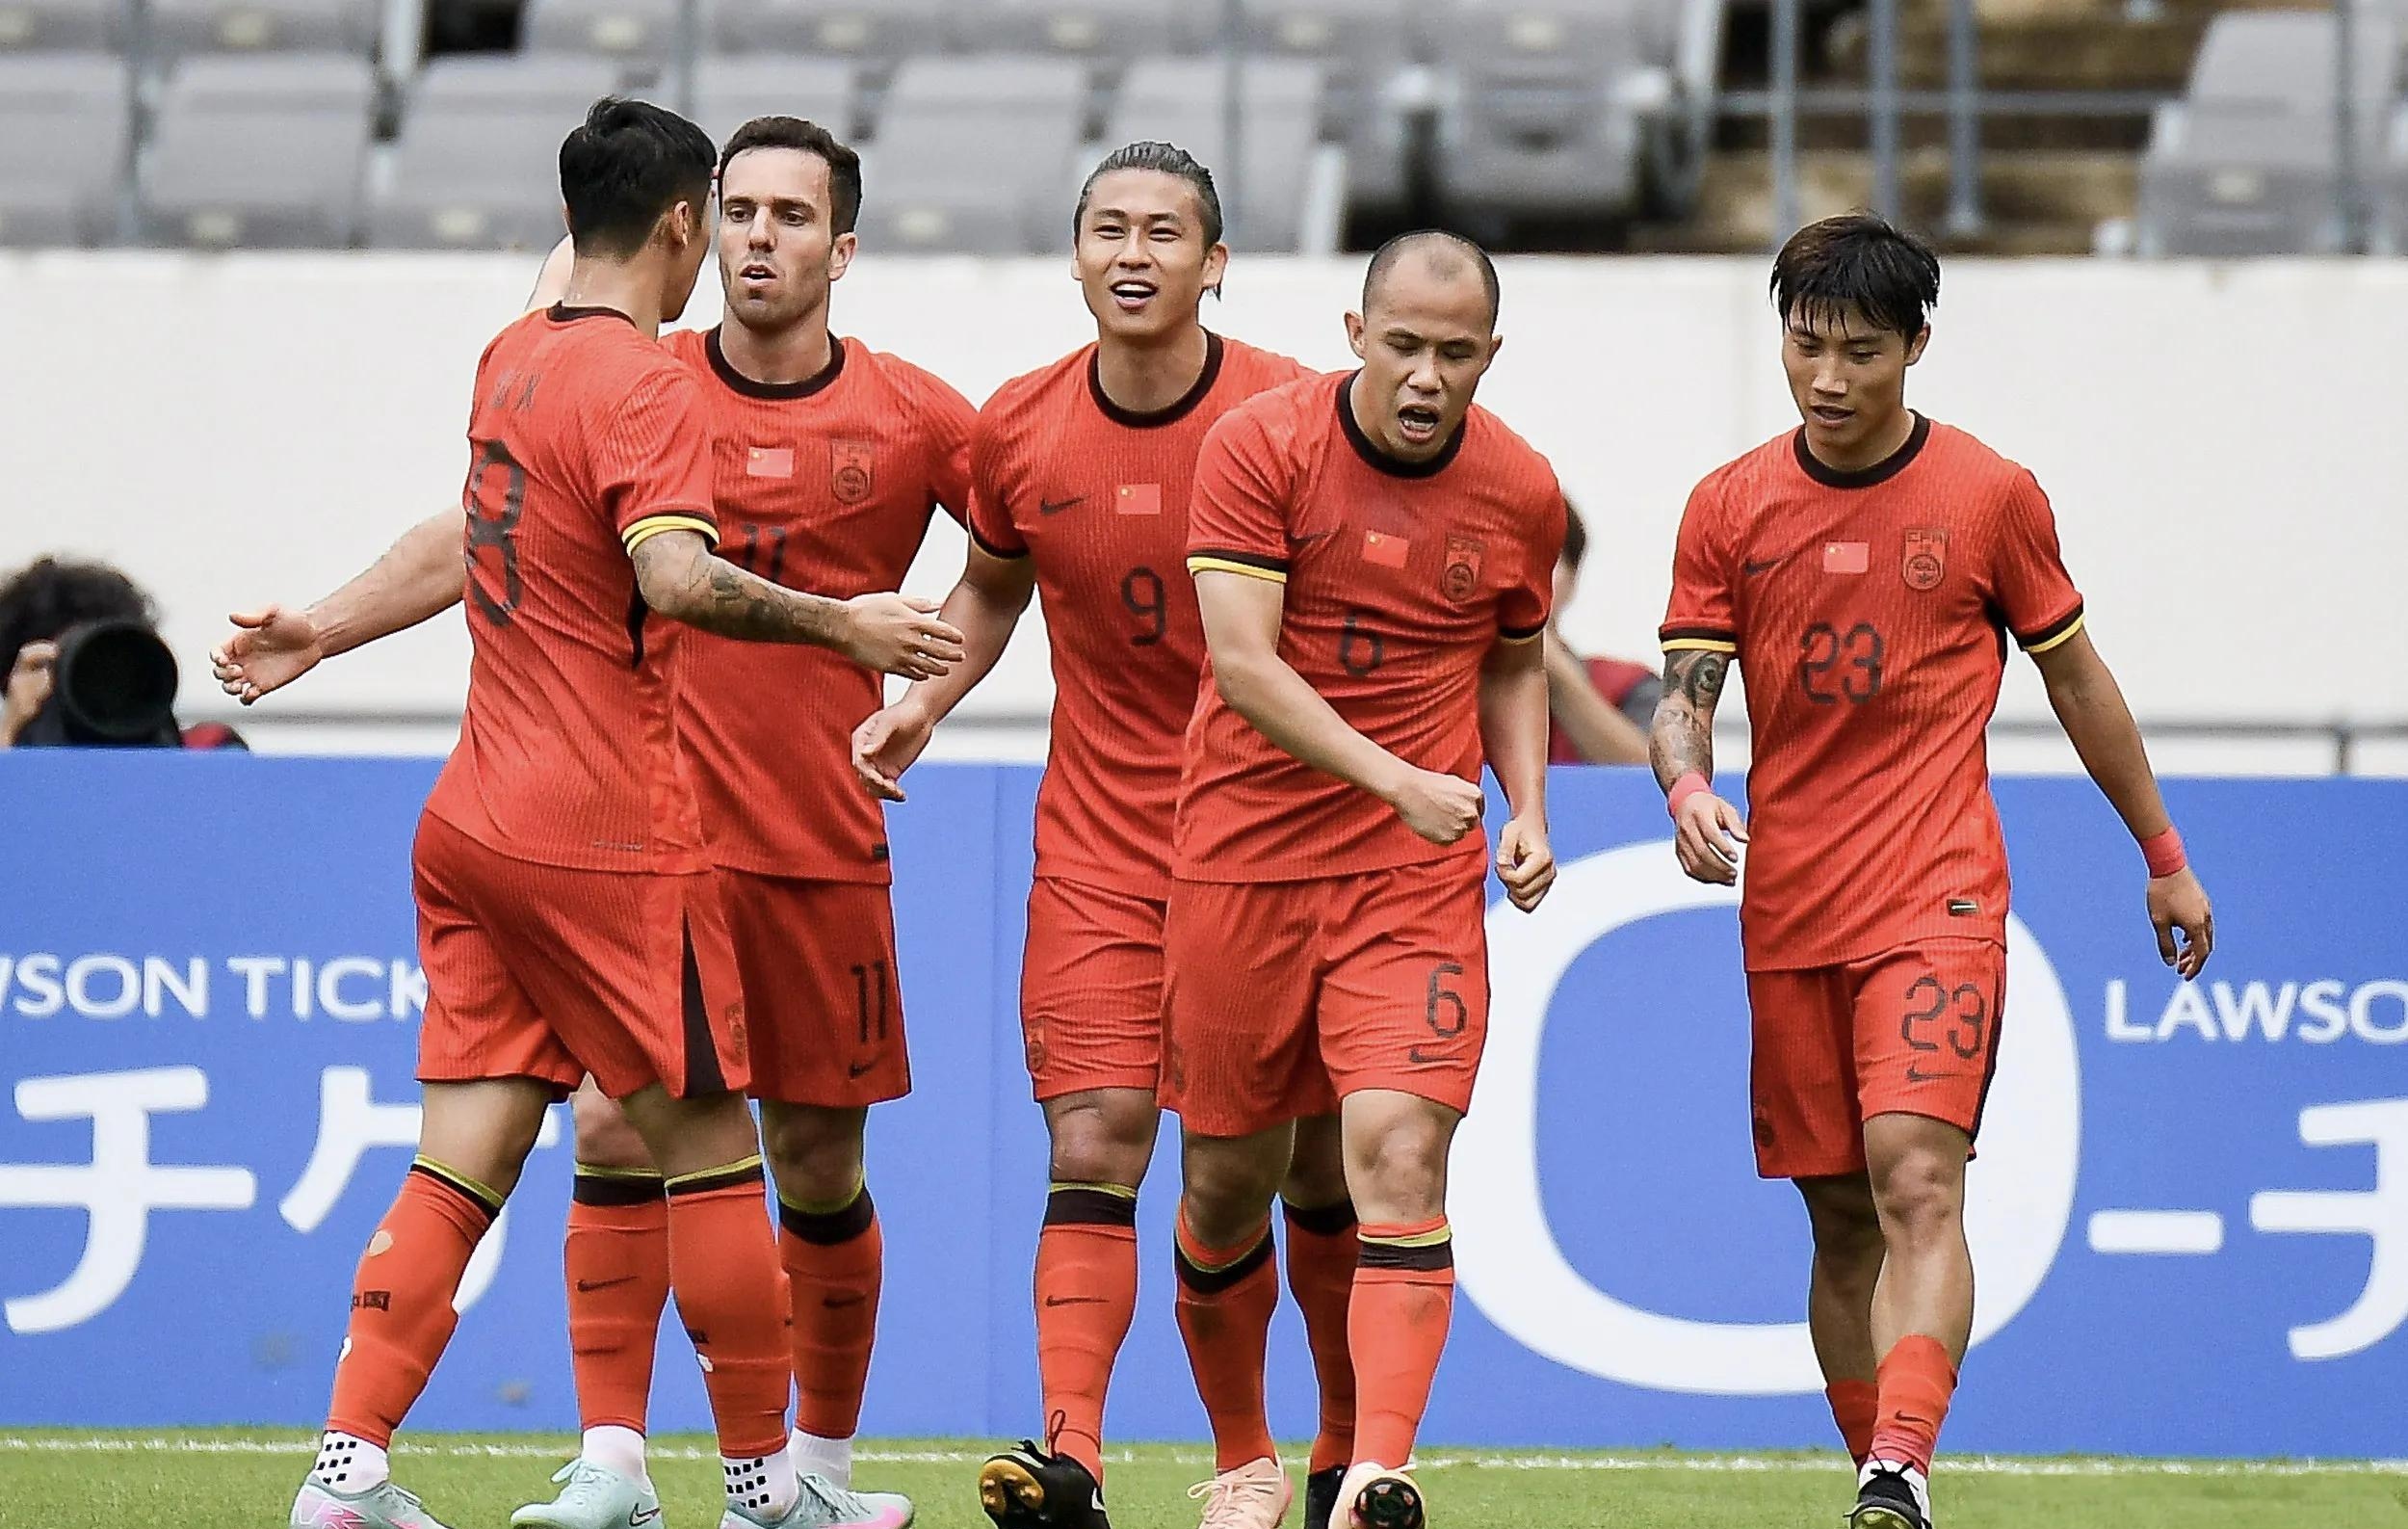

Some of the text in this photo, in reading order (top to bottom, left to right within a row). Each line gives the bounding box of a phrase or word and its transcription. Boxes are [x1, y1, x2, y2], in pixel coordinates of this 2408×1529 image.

[466, 438, 526, 628] 8
[741, 523, 786, 584] 11
[1121, 566, 1166, 646] 9
[1339, 606, 1384, 678] 6
[1799, 621, 1885, 704] 23
[0, 954, 210, 1020] SON
[851, 960, 888, 1042] 11
[1426, 962, 1467, 1039] 6
[1901, 976, 1986, 1059] 23
[2105, 978, 2408, 1044] LAWSO
